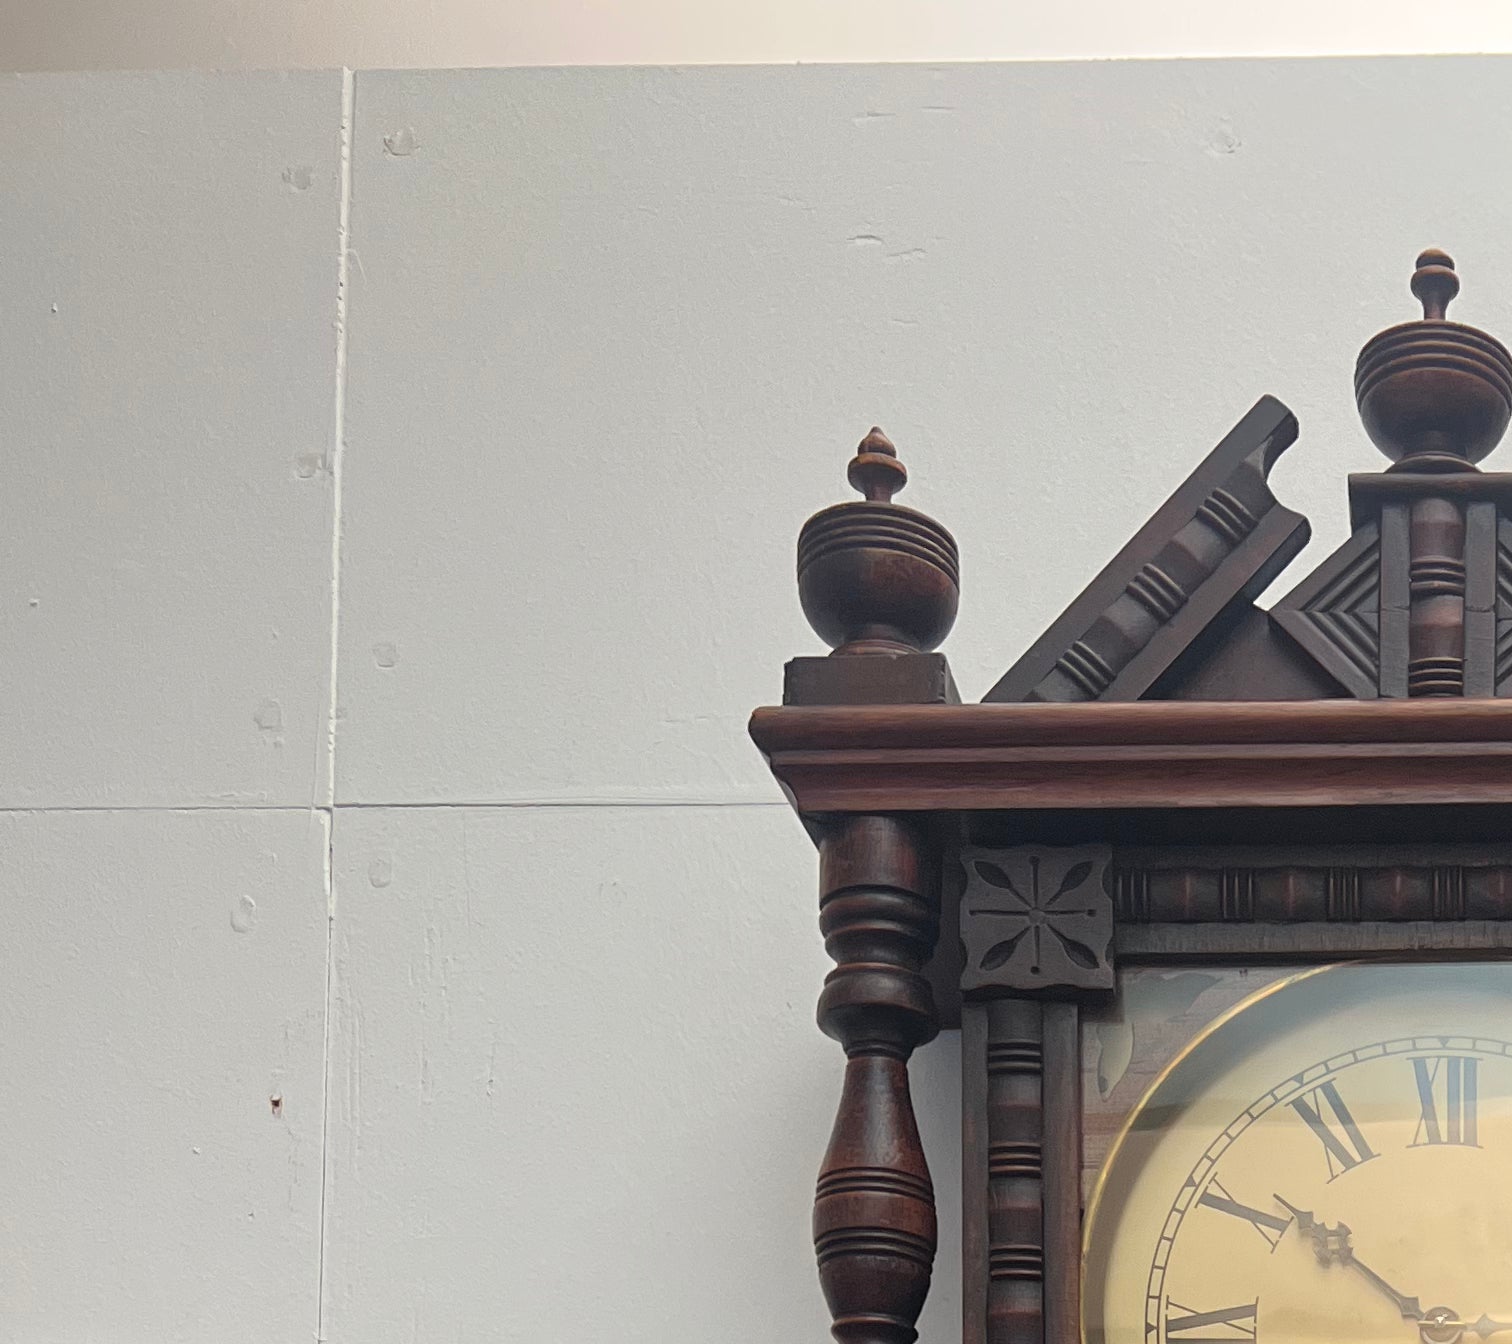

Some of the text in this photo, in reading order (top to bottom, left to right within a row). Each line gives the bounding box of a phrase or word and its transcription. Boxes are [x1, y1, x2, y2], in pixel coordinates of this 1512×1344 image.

[1284, 1077, 1381, 1184] XI
[1406, 1056, 1483, 1148] XII
[1195, 1173, 1294, 1254] X
